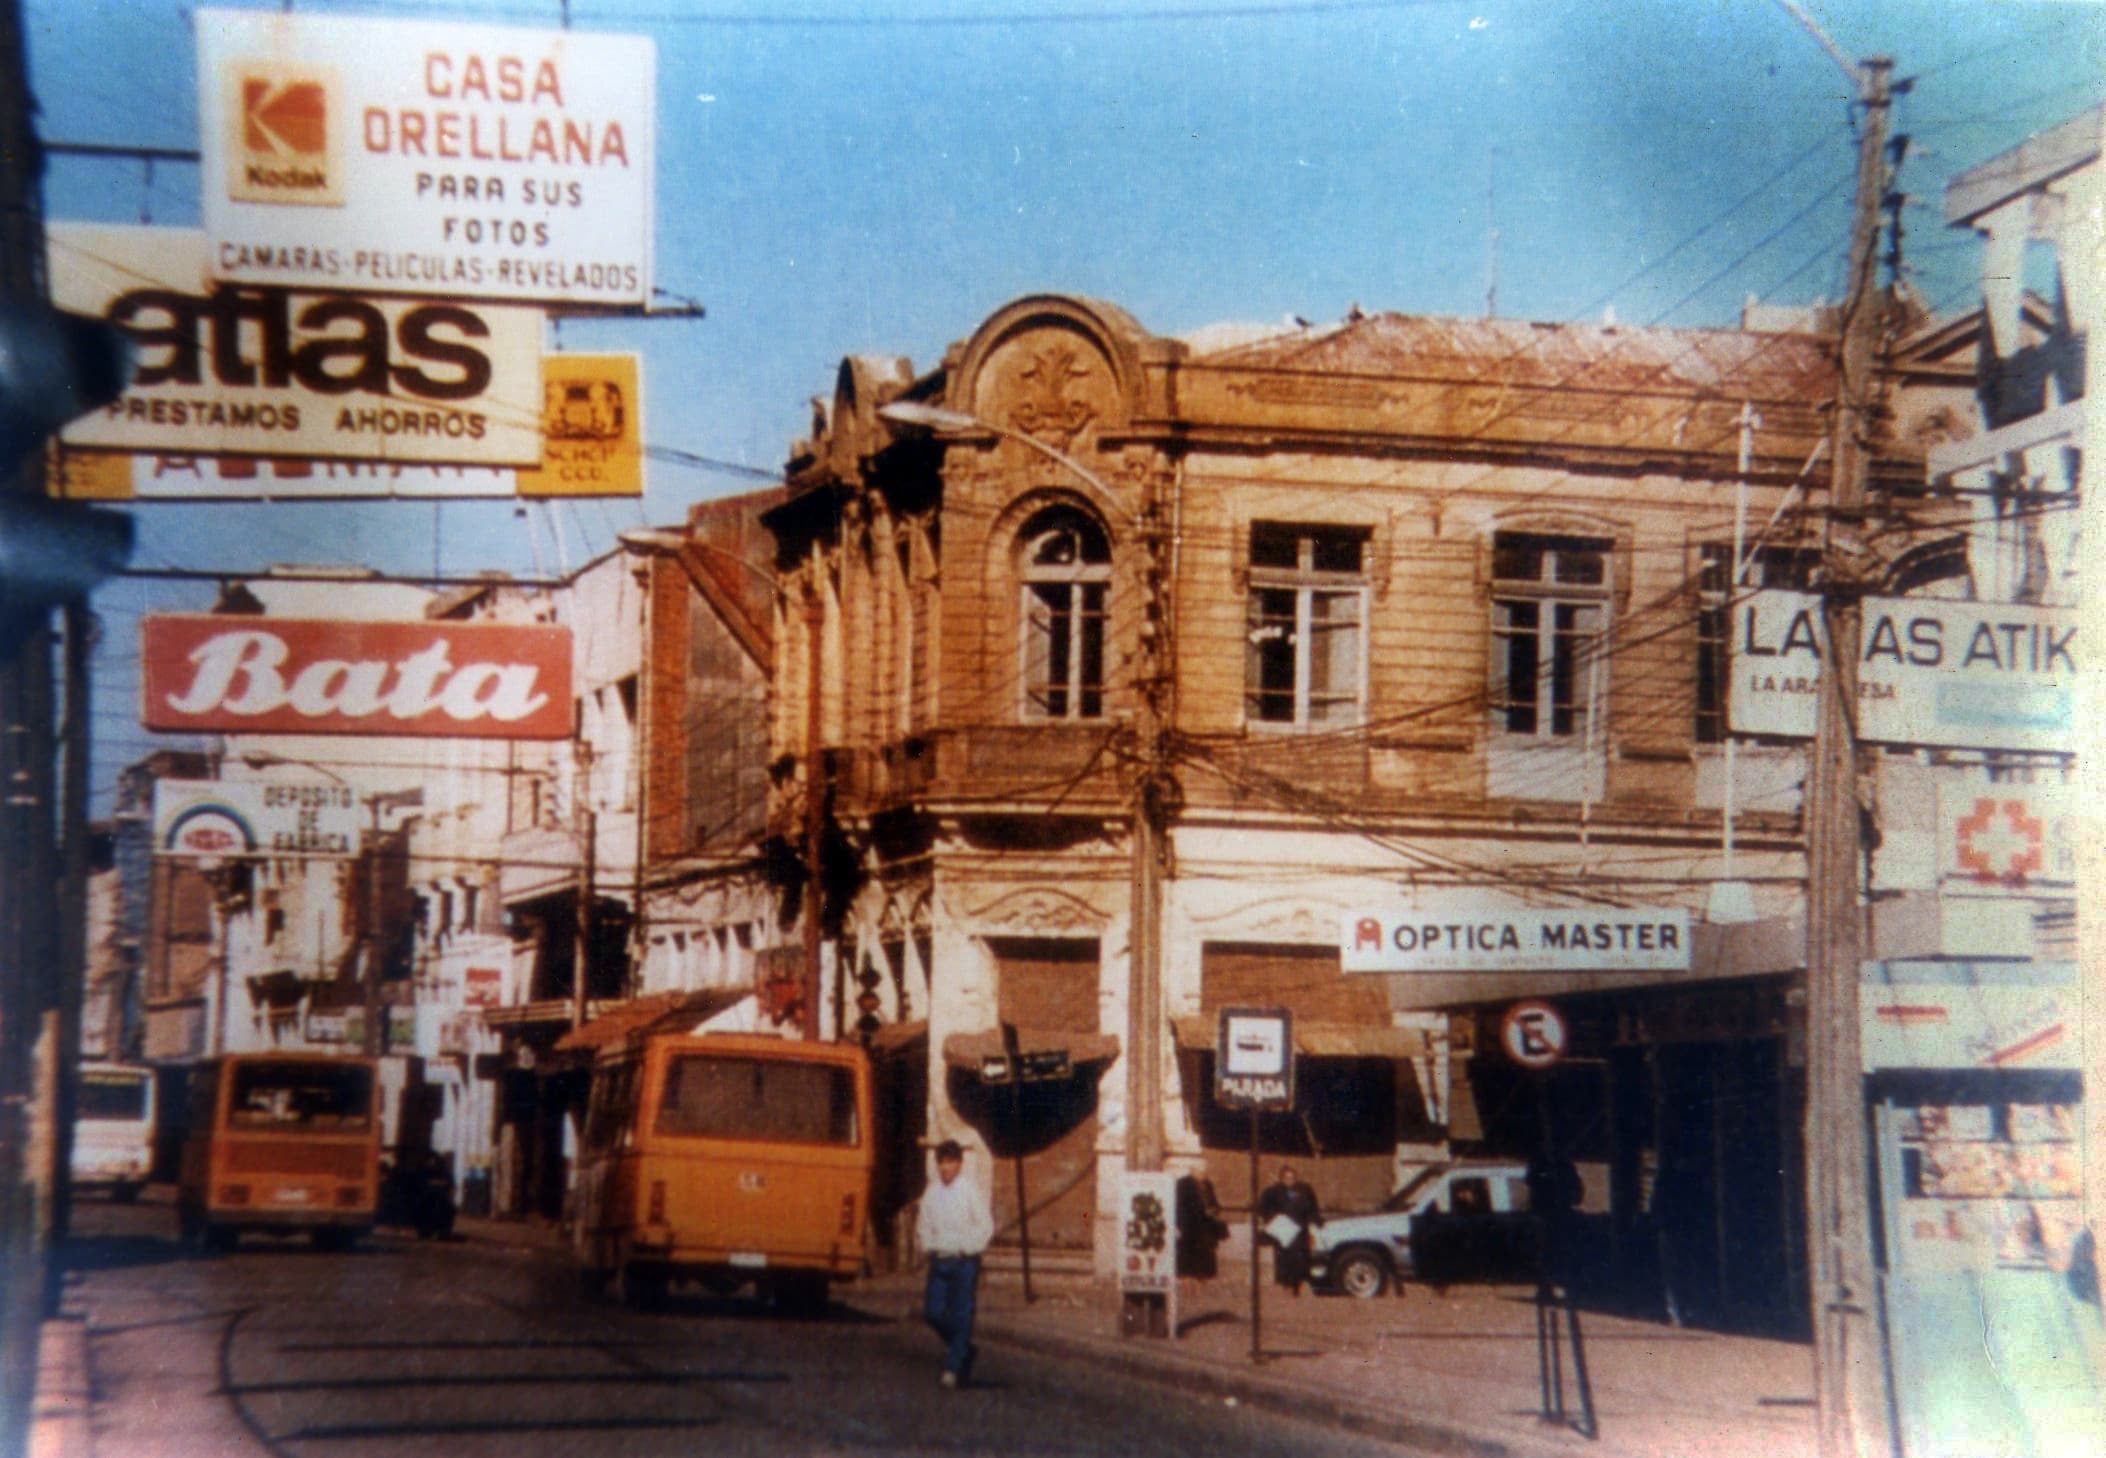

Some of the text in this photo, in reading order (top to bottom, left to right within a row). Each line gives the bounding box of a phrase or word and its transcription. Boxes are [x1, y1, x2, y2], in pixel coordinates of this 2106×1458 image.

[425, 52, 564, 107] CASA
[363, 106, 629, 167] ORELLANA
[244, 167, 327, 190] Kodak
[416, 172, 583, 207] PARA SUS
[443, 217, 550, 246] FOTOS
[106, 284, 493, 401] atlas
[106, 397, 487, 439] PRESTAMOS AHORROS
[1745, 607, 2078, 674] LAAS ATIK
[167, 630, 549, 722] Bata
[1393, 924, 1679, 951] OPTICA MASTER
